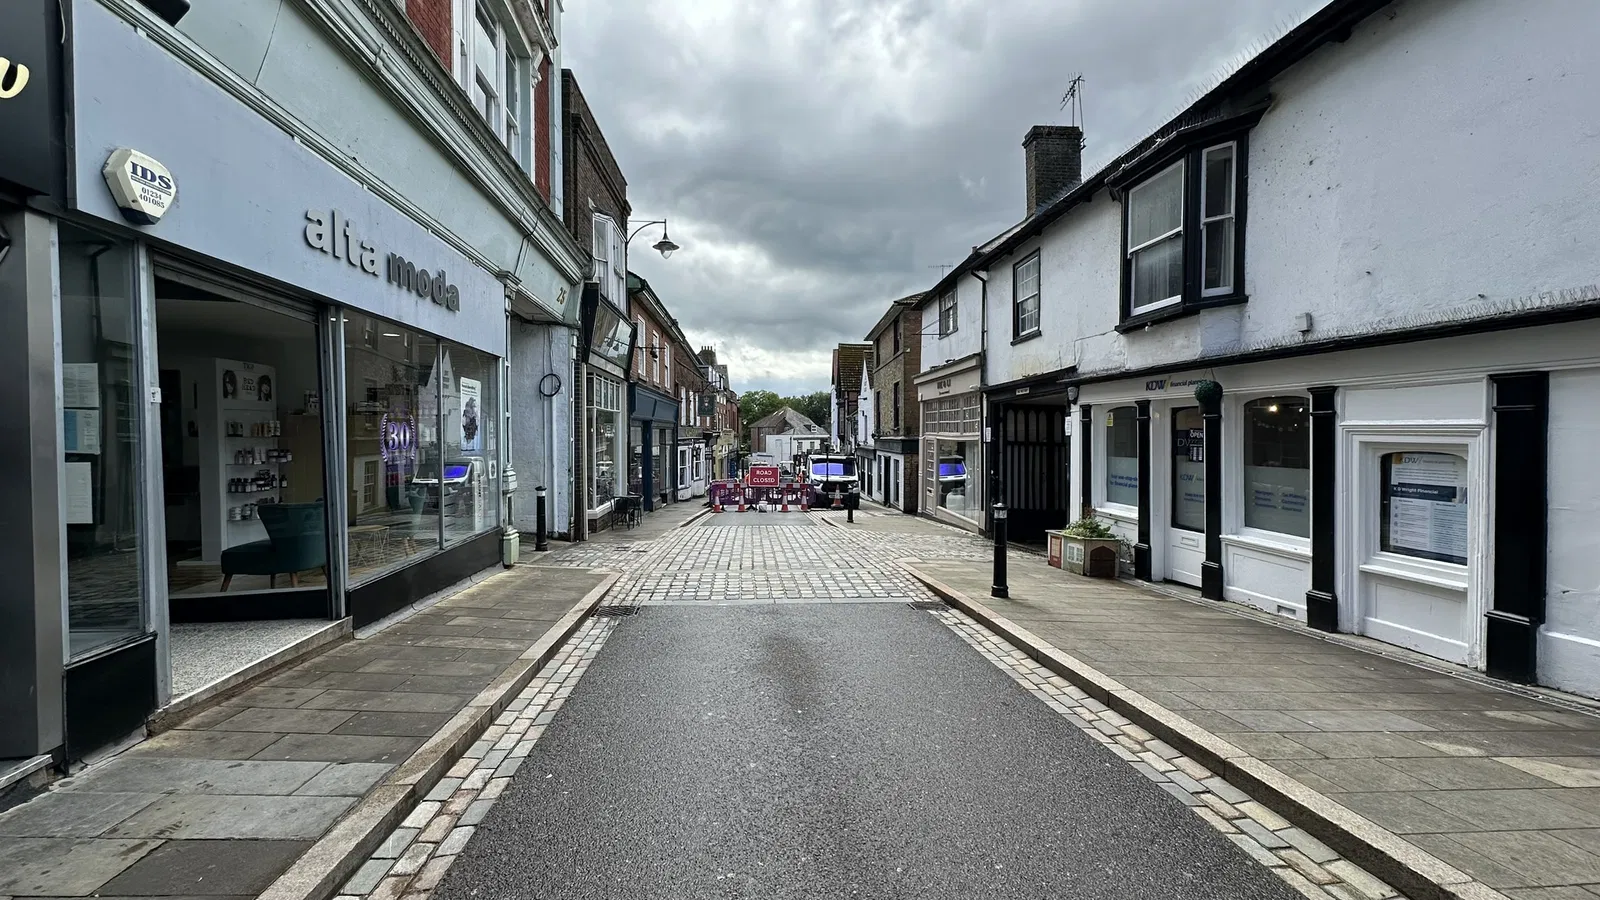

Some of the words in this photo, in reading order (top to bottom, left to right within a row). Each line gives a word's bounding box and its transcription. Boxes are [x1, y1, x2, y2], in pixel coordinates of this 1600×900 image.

[130, 161, 172, 190] IDS
[139, 193, 165, 209] 401085
[142, 187, 162, 200] 01234
[304, 208, 379, 278] alta
[387, 251, 461, 313] moda
[556, 286, 567, 305] 25
[1145, 380, 1167, 391] KDW
[1170, 380, 1187, 388] financial
[389, 422, 410, 450] 30
